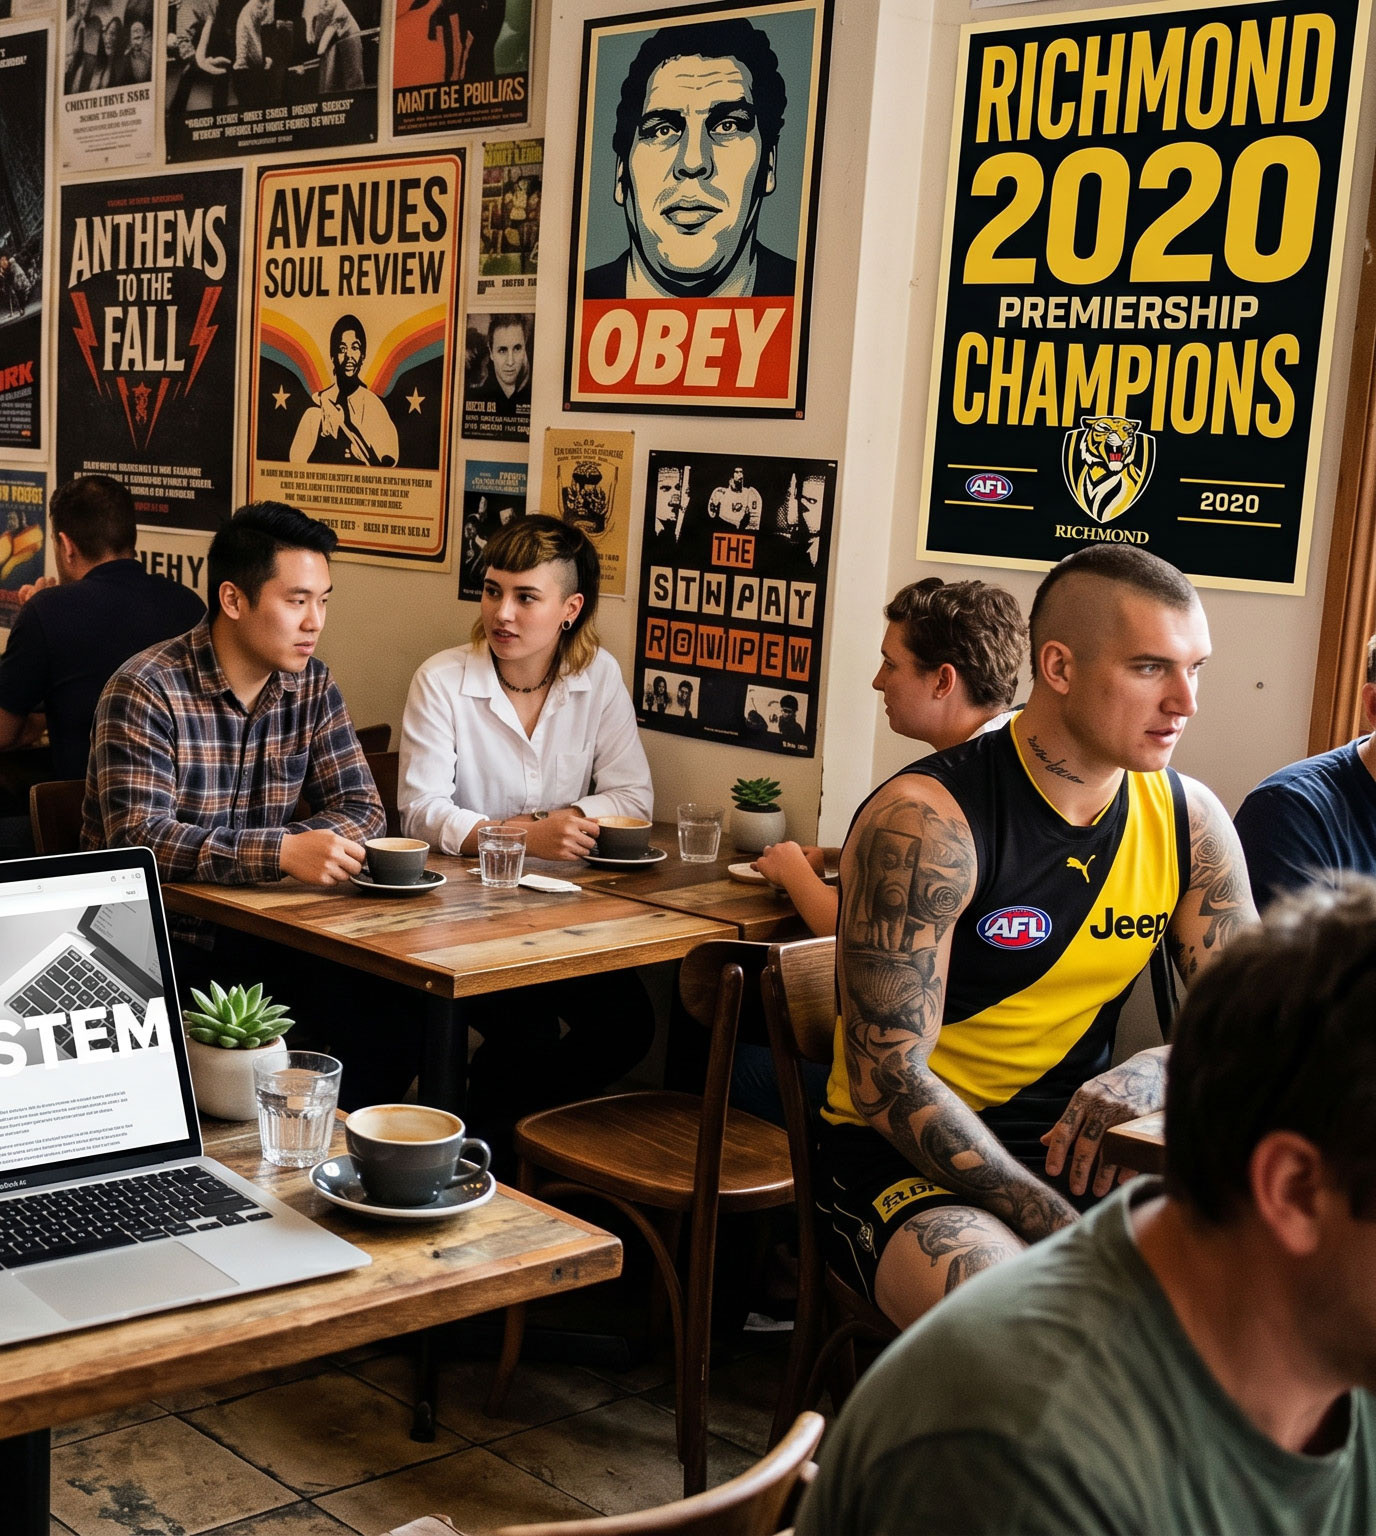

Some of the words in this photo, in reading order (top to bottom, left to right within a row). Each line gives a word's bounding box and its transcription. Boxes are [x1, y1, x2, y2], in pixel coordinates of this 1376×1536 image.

[975, 13, 1336, 143] RICHMOND
[266, 175, 448, 250] AVENUES
[962, 135, 1322, 285] 2020
[68, 205, 227, 289] ANTHEMS
[116, 274, 137, 302] TO
[140, 272, 173, 302] THE
[264, 255, 330, 299] SOUL
[338, 250, 446, 297] REVIEW
[997, 295, 1259, 330] PREMIERSHIP
[103, 306, 186, 371] FALL
[587, 307, 787, 388] OBEY
[952, 331, 1301, 439] CHAMPIONS
[969, 478, 1010, 496] AFL
[1200, 491, 1260, 514] 2020
[714, 536, 753, 564] THE
[1054, 524, 1150, 545] RICHMOND
[985, 917, 1046, 938] AFL
[1090, 907, 1169, 943] Jeep
